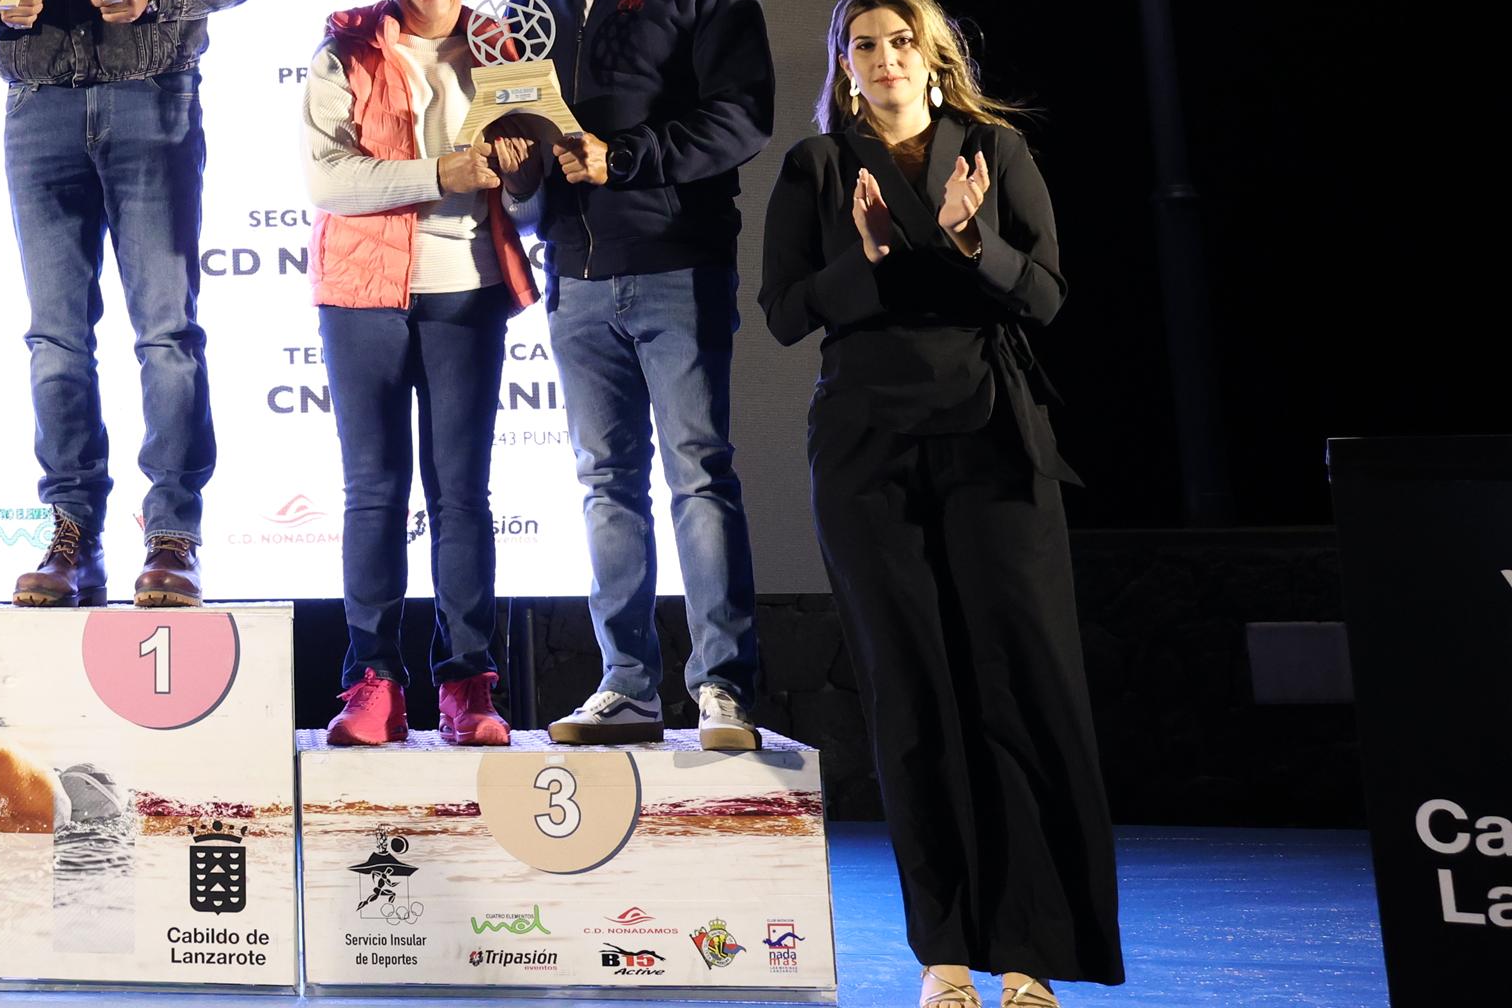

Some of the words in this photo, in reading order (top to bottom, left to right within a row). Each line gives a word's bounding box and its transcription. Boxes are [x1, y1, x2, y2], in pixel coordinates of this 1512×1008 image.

[201, 248, 261, 276] CD
[138, 625, 172, 694] 1
[534, 765, 582, 839] 3
[167, 927, 240, 945] Cabildo
[246, 929, 270, 946] de
[345, 933, 388, 946] Servicio
[390, 934, 427, 946] Insular
[171, 947, 267, 966] Lanzarote
[355, 952, 369, 965] de
[371, 952, 418, 968] Deportes
[485, 949, 558, 967] Tripasión
[769, 948, 797, 960] nada
[614, 967, 665, 976] Active
